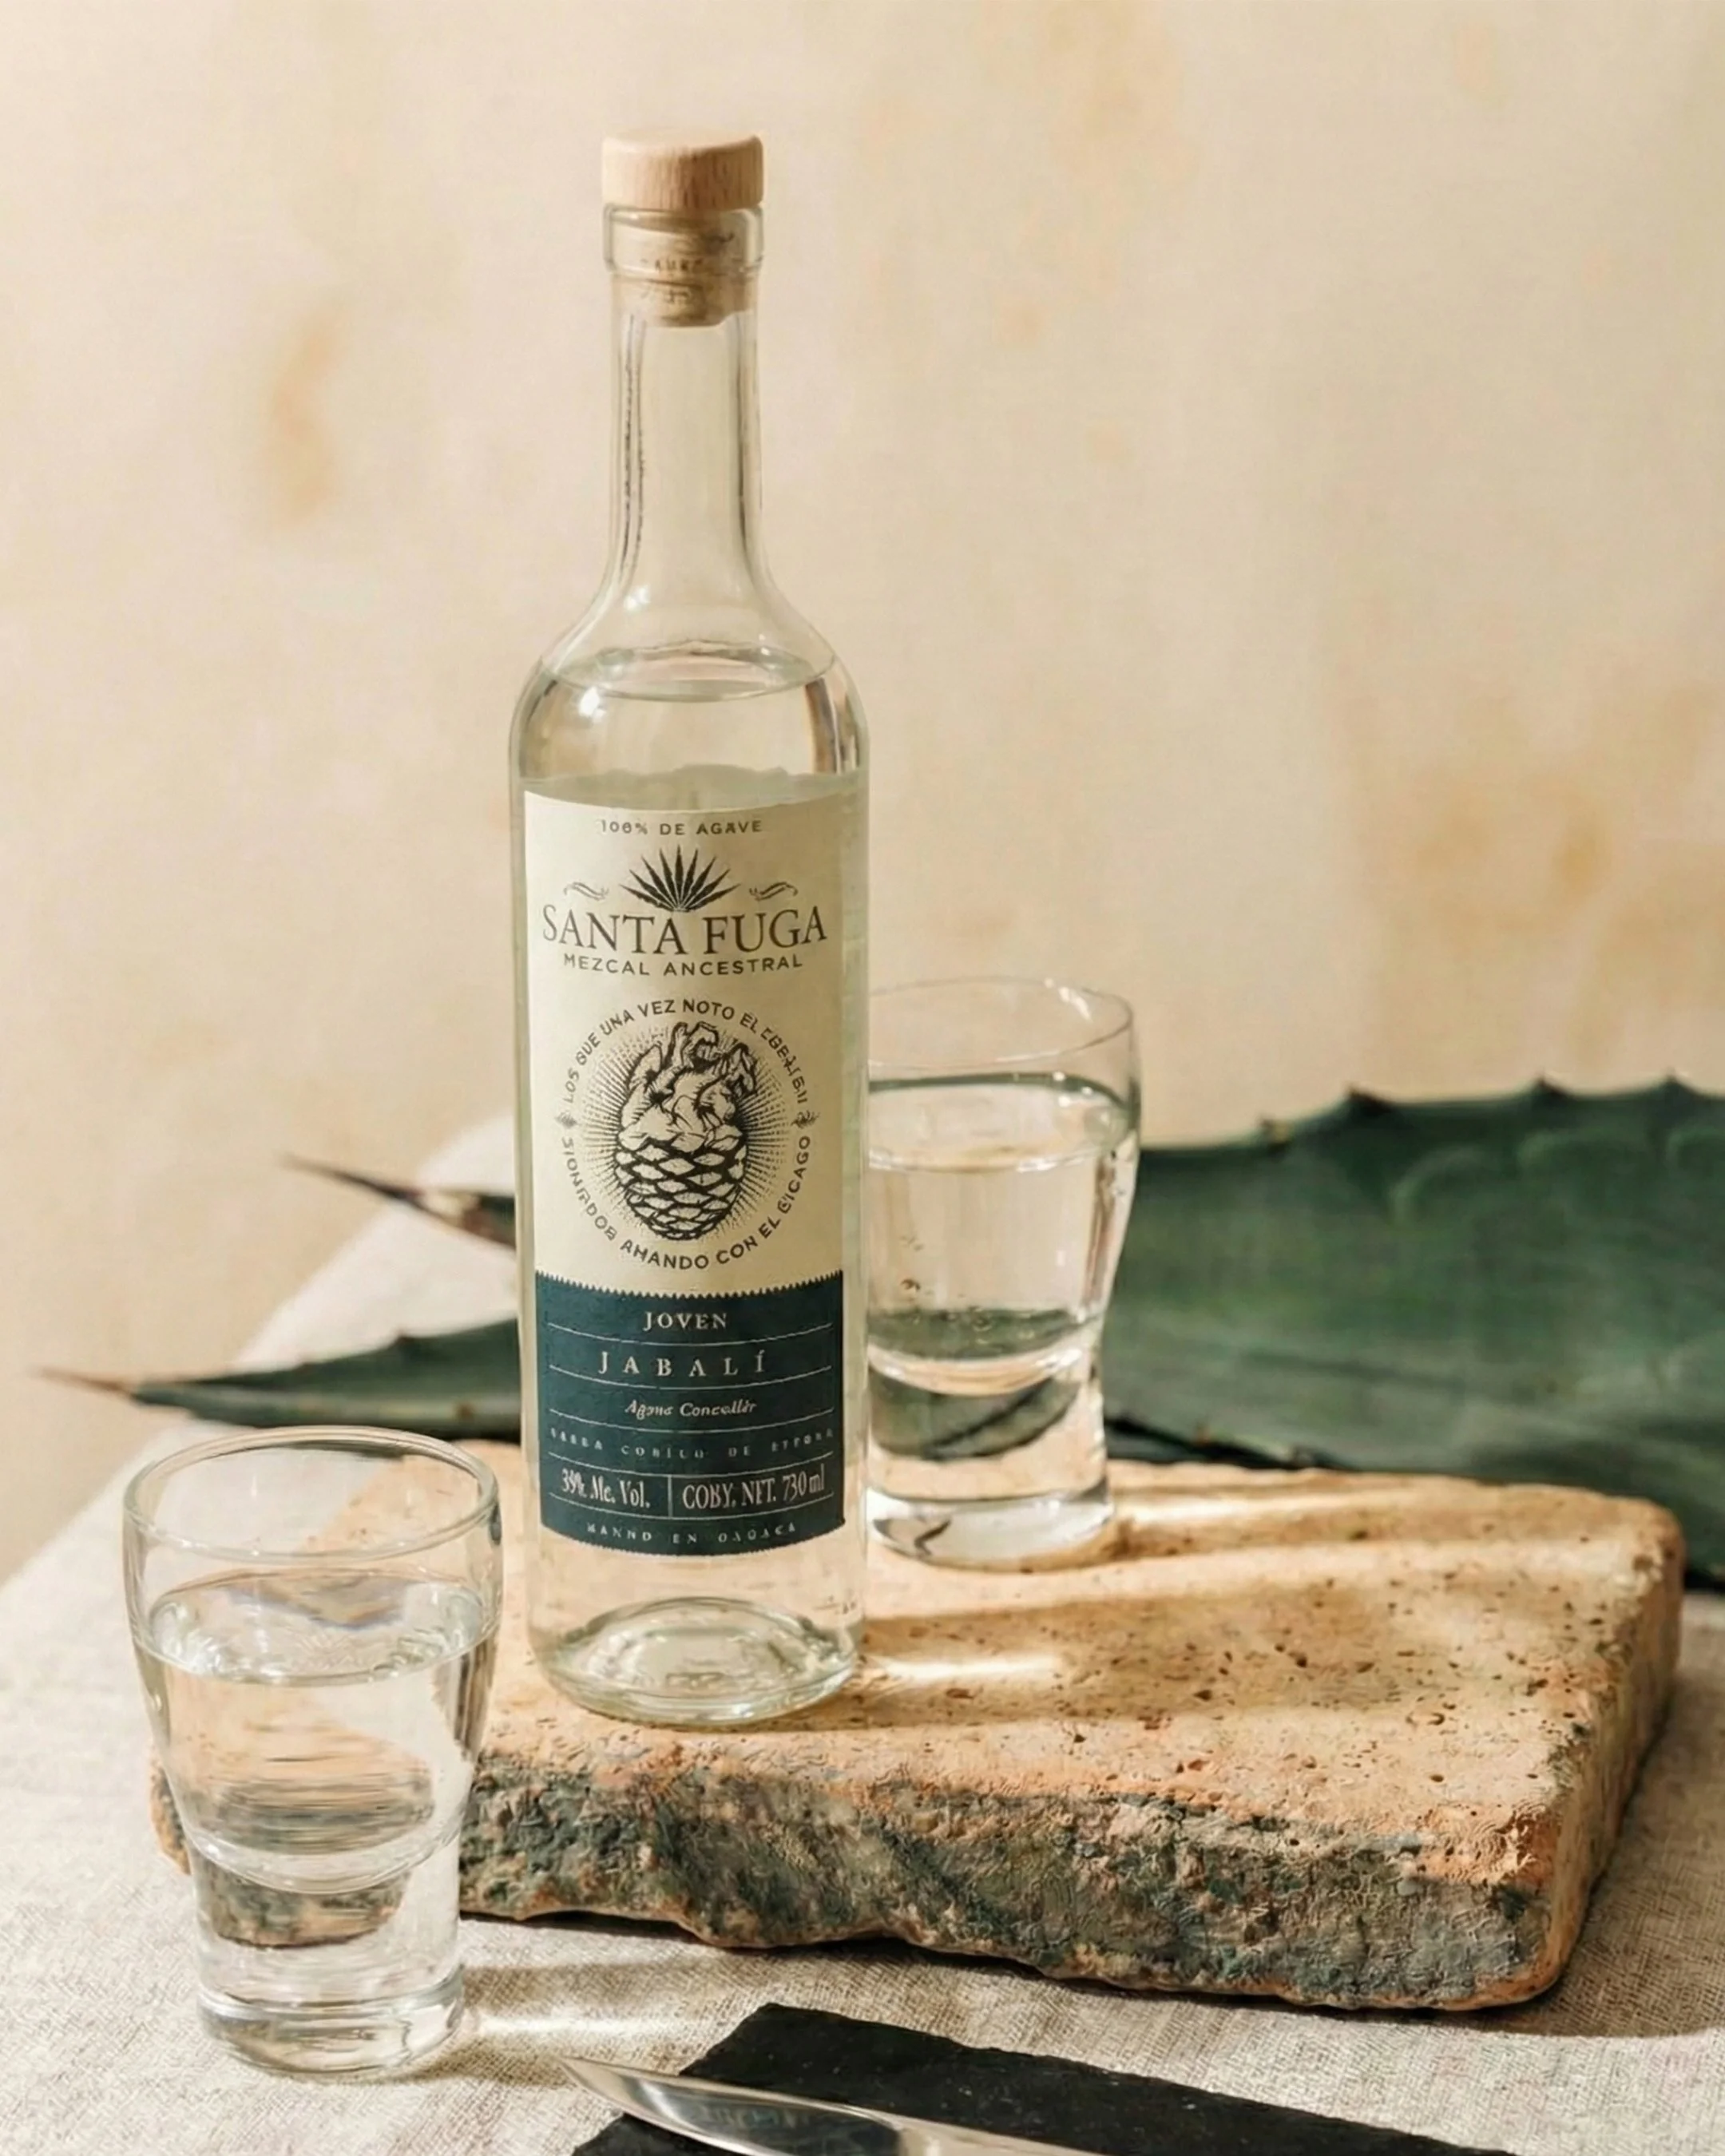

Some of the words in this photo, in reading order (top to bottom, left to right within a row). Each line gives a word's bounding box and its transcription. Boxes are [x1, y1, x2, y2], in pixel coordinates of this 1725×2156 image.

[660, 822, 685, 835] DE
[696, 820, 762, 835] AGAVE
[542, 904, 688, 955] SANTA
[703, 905, 827, 955] FUGA
[564, 953, 650, 976] MEZCAL
[663, 954, 803, 977] ANCESTRAL
[599, 1009, 635, 1036] UNA
[636, 999, 676, 1017] VEZ
[683, 998, 735, 1021] NOTO
[643, 1312, 727, 1332] JOVEN
[598, 1349, 766, 1377] JABALÍ
